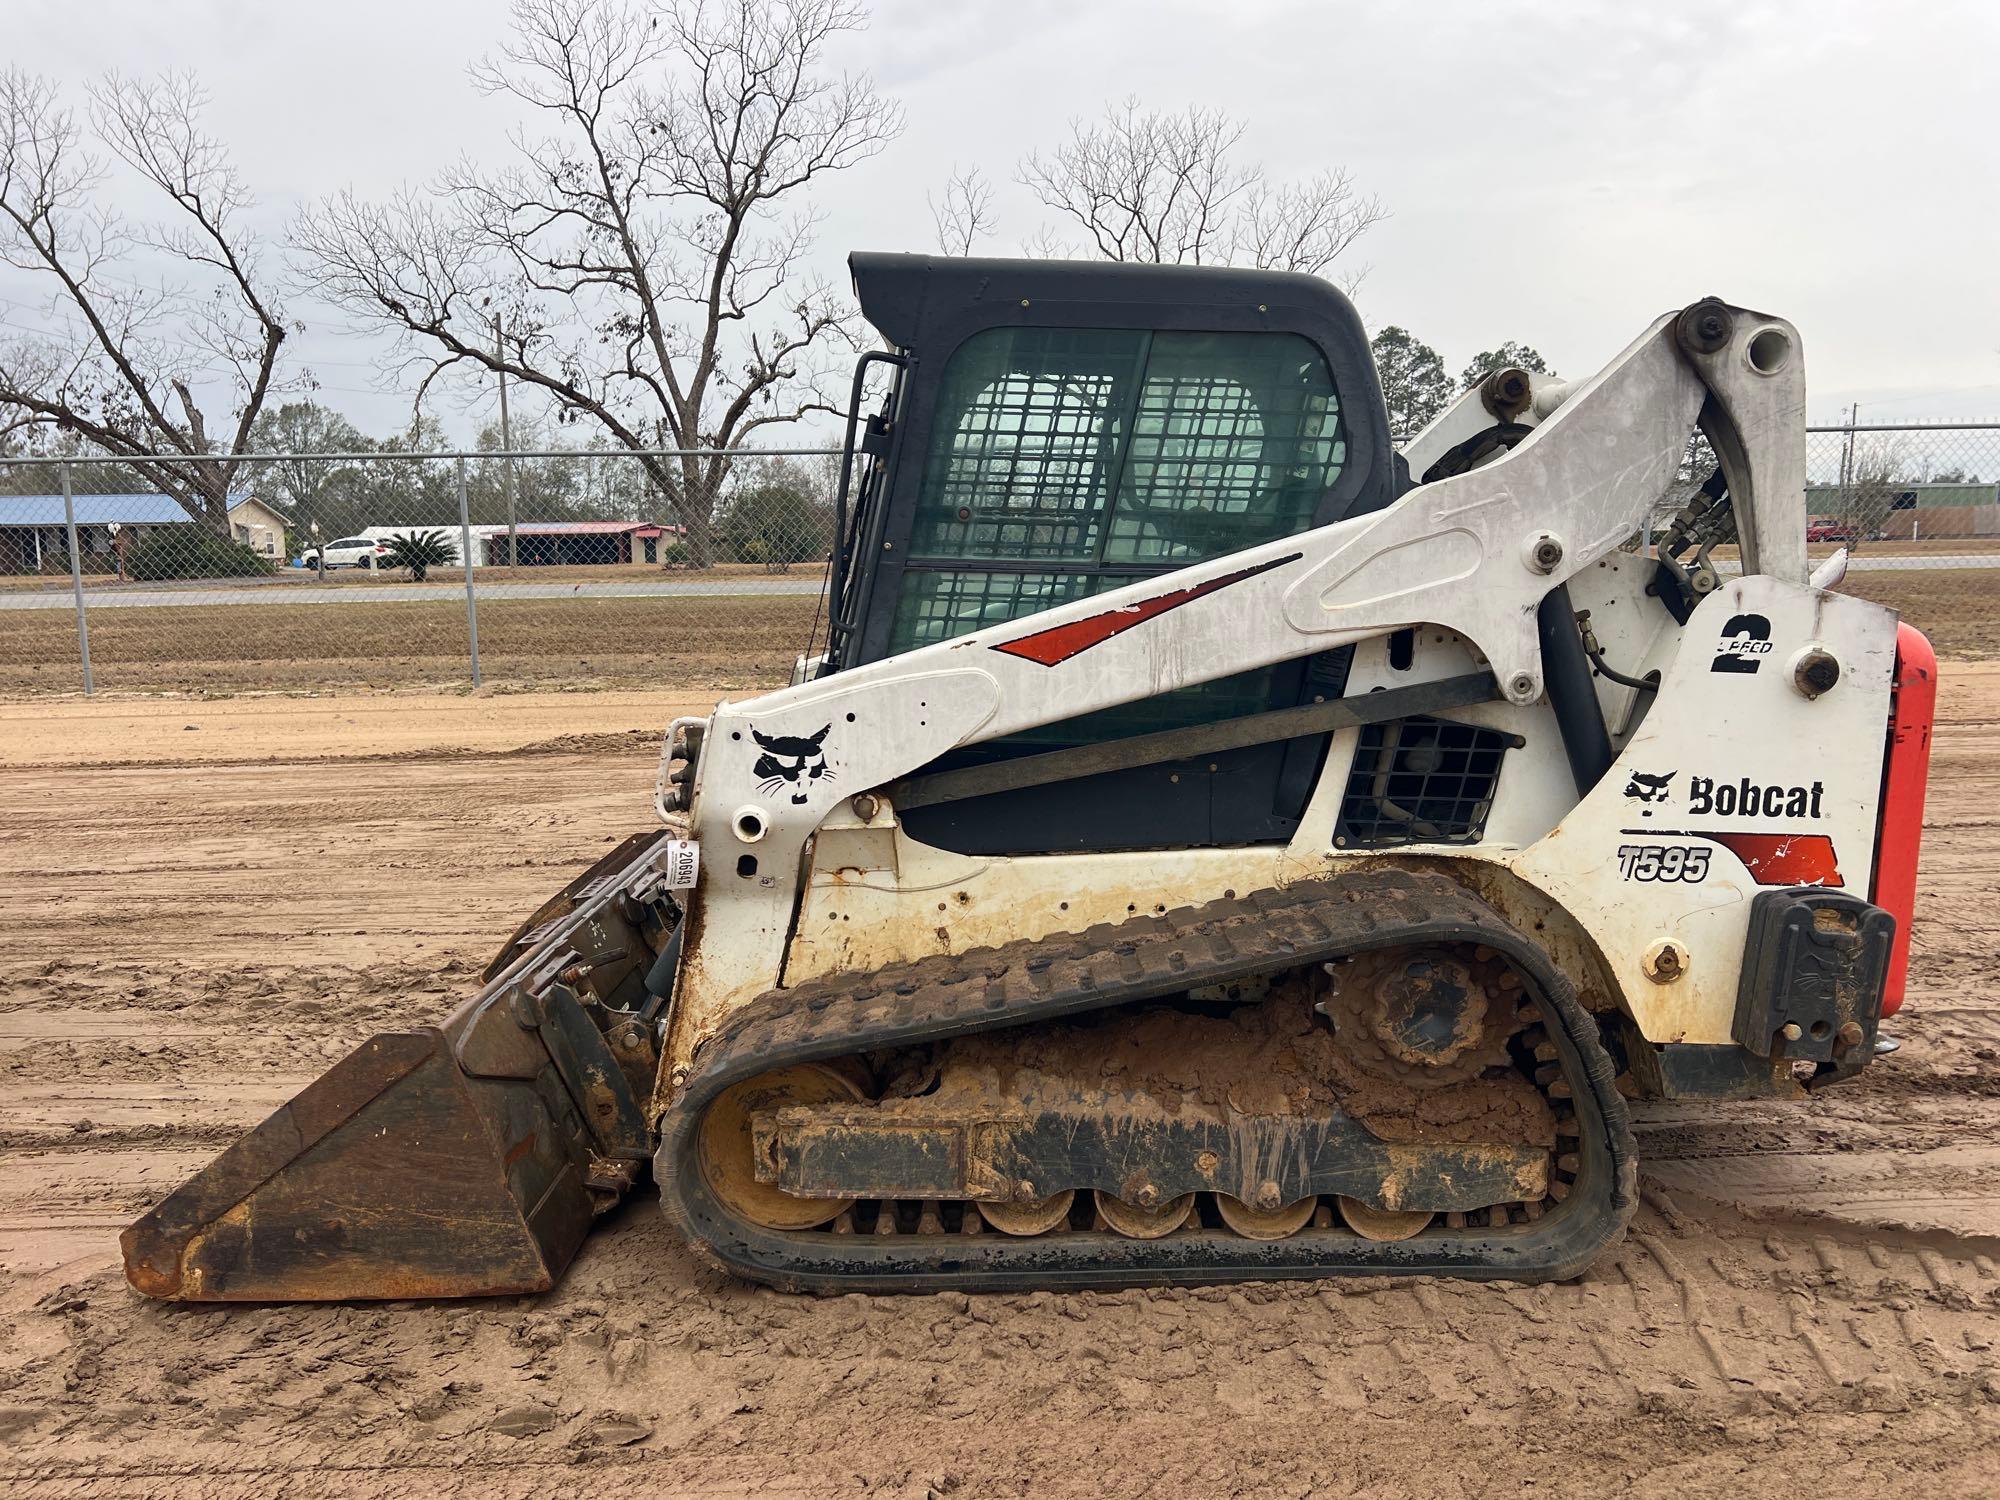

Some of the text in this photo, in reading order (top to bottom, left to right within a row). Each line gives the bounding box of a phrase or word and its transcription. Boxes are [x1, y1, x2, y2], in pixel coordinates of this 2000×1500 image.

[1711, 614, 1771, 674] 2
[1689, 776, 1824, 818] Bobcat
[677, 851, 693, 885] 206943
[1618, 845, 1712, 883] T595
